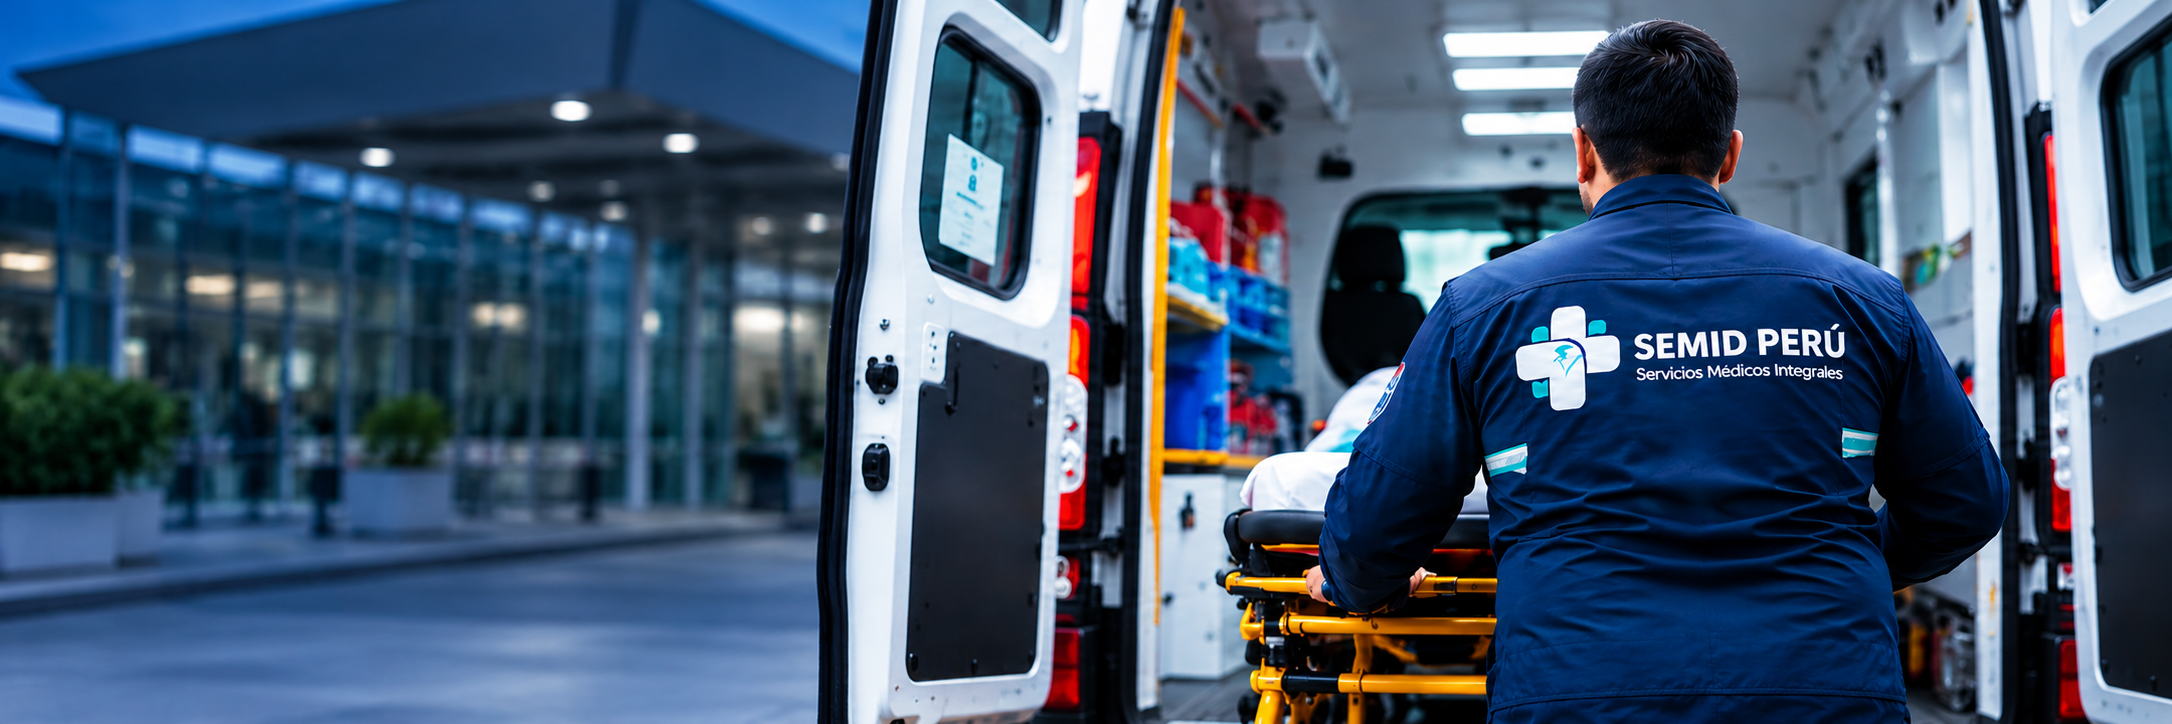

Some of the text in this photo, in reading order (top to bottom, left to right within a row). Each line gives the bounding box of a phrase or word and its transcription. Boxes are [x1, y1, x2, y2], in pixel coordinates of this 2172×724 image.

[1633, 323, 1846, 361] SEMID PERÚ
[1636, 362, 1844, 381] Servicios Médicos Integrales
